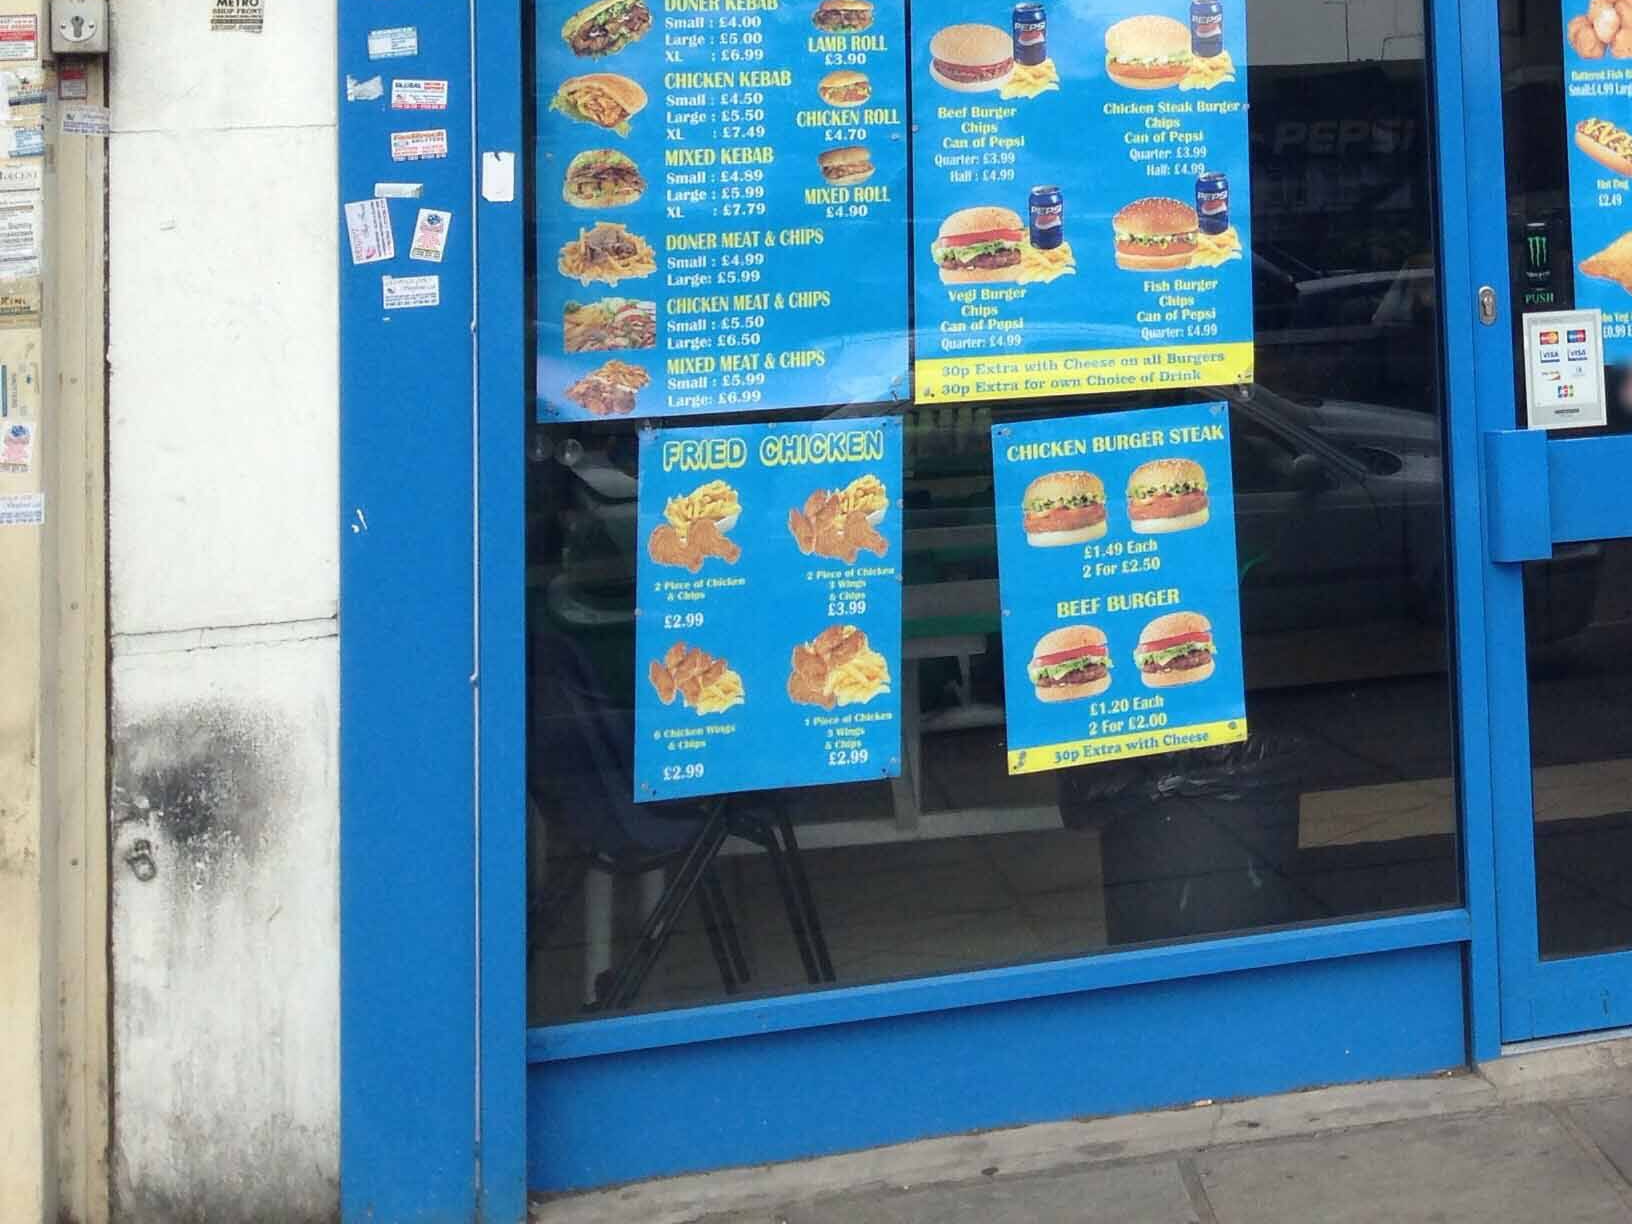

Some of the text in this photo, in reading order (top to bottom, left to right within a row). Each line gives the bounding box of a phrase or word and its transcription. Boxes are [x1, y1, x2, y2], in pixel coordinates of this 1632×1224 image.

[665, 16, 704, 28] Small
[665, 34, 704, 47] Large
[808, 34, 887, 53] LAMB ROLL
[665, 48, 763, 63] XL £6.99
[664, 70, 791, 89] CHICKEN KEBAB
[796, 108, 899, 127] CHICKEN ROLL
[971, 106, 1017, 120] Burger
[665, 147, 774, 167] MIXED KEBAB
[804, 185, 890, 204] MIXED ROLL
[666, 235, 717, 251] DONER
[722, 232, 760, 248] MEAT
[780, 228, 824, 245] CHIPS
[976, 380, 1018, 393] Extra
[1024, 377, 1046, 390] for
[1087, 373, 1135, 386] Choice
[1140, 371, 1154, 383] of
[663, 430, 884, 472] FRIED CHICKEN
[1007, 424, 1224, 462] CHICKEN BURGER STEAK
[1127, 538, 1158, 554] Each
[1082, 556, 1161, 579] 2 For £2.50
[1056, 588, 1180, 618] BEEF BURGER
[1083, 743, 1122, 759] Extra
[1126, 737, 1159, 753] with
[1162, 730, 1209, 747] Cheese
